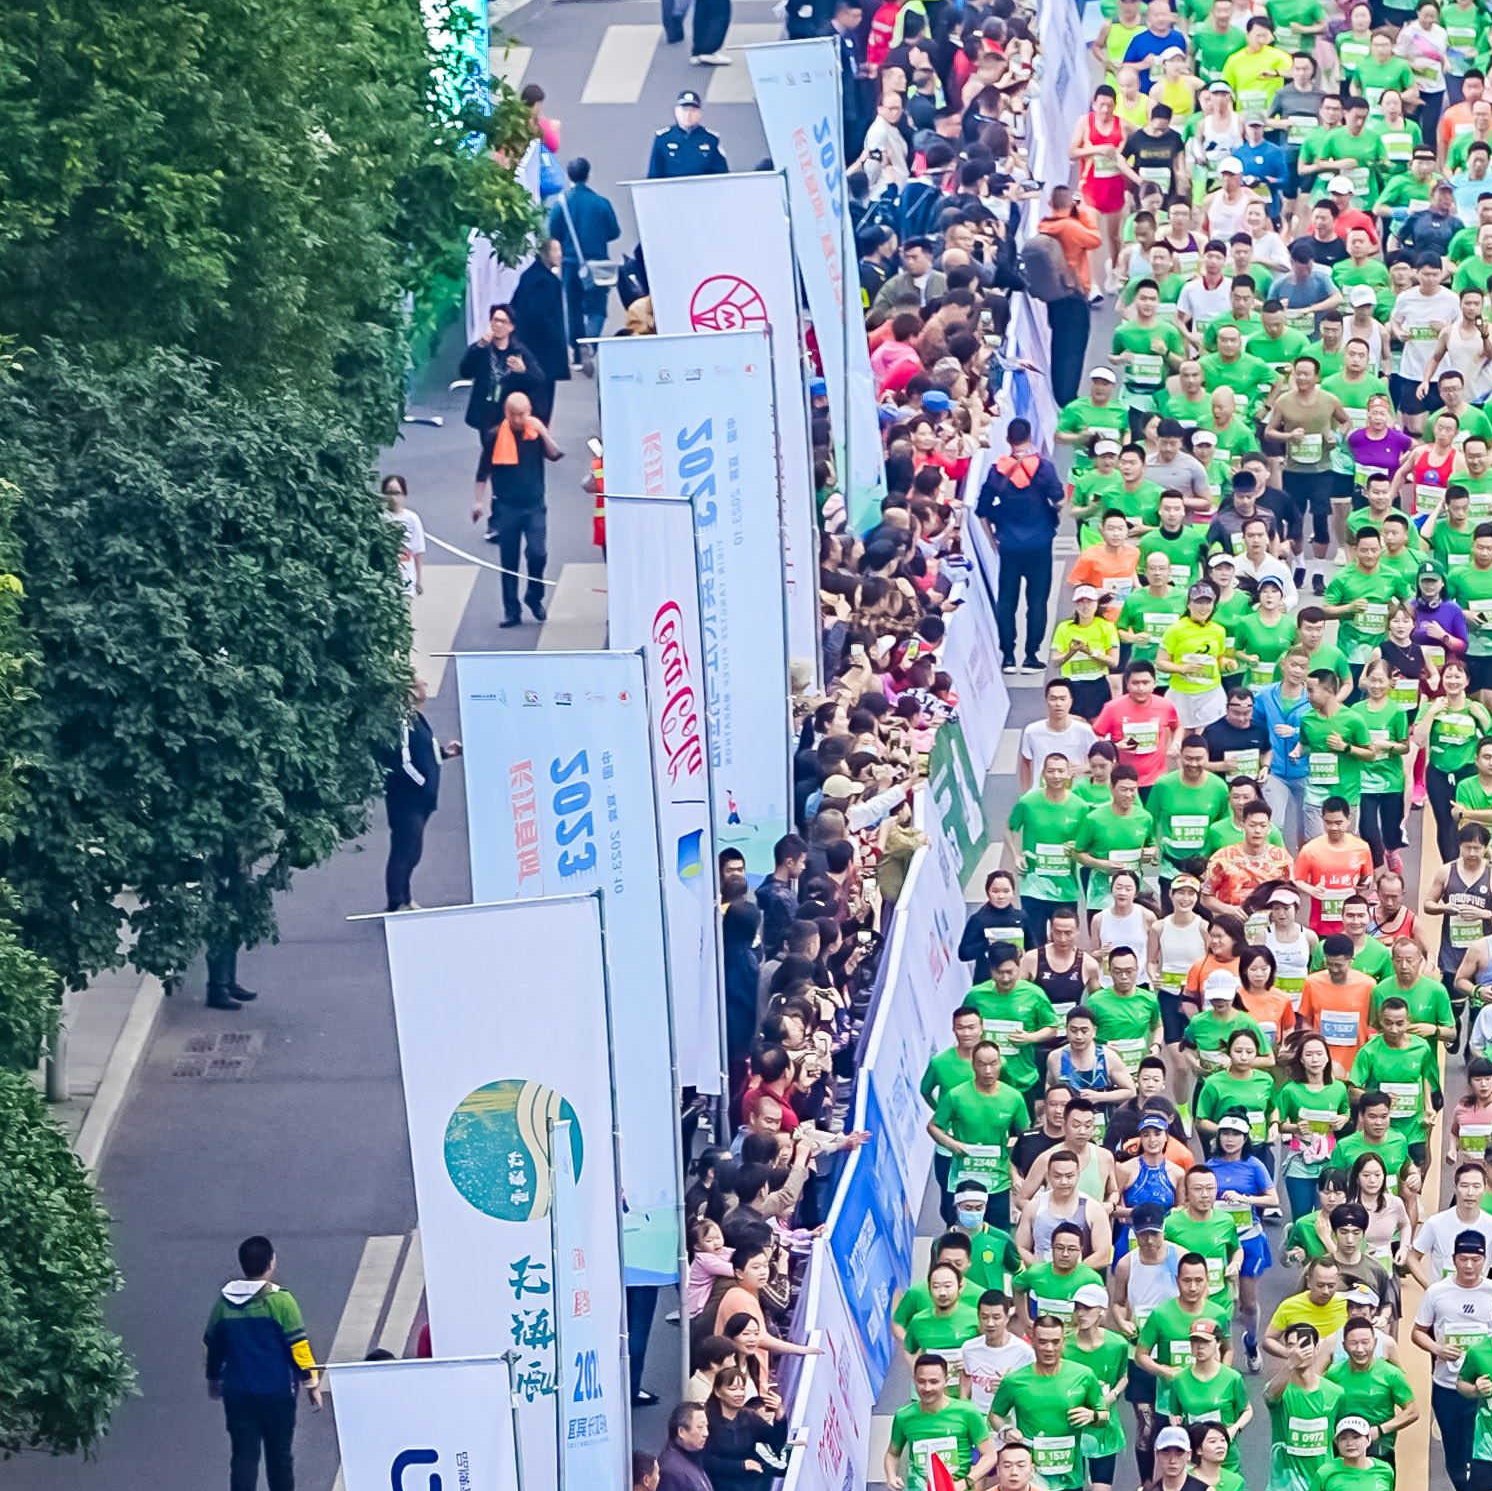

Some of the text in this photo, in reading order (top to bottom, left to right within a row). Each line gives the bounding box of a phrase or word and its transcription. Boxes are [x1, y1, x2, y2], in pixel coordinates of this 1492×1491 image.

[1175, 828, 1181, 837] B
[964, 1157, 997, 1168] B 2340
[1038, 1449, 1071, 1461] B 1539
